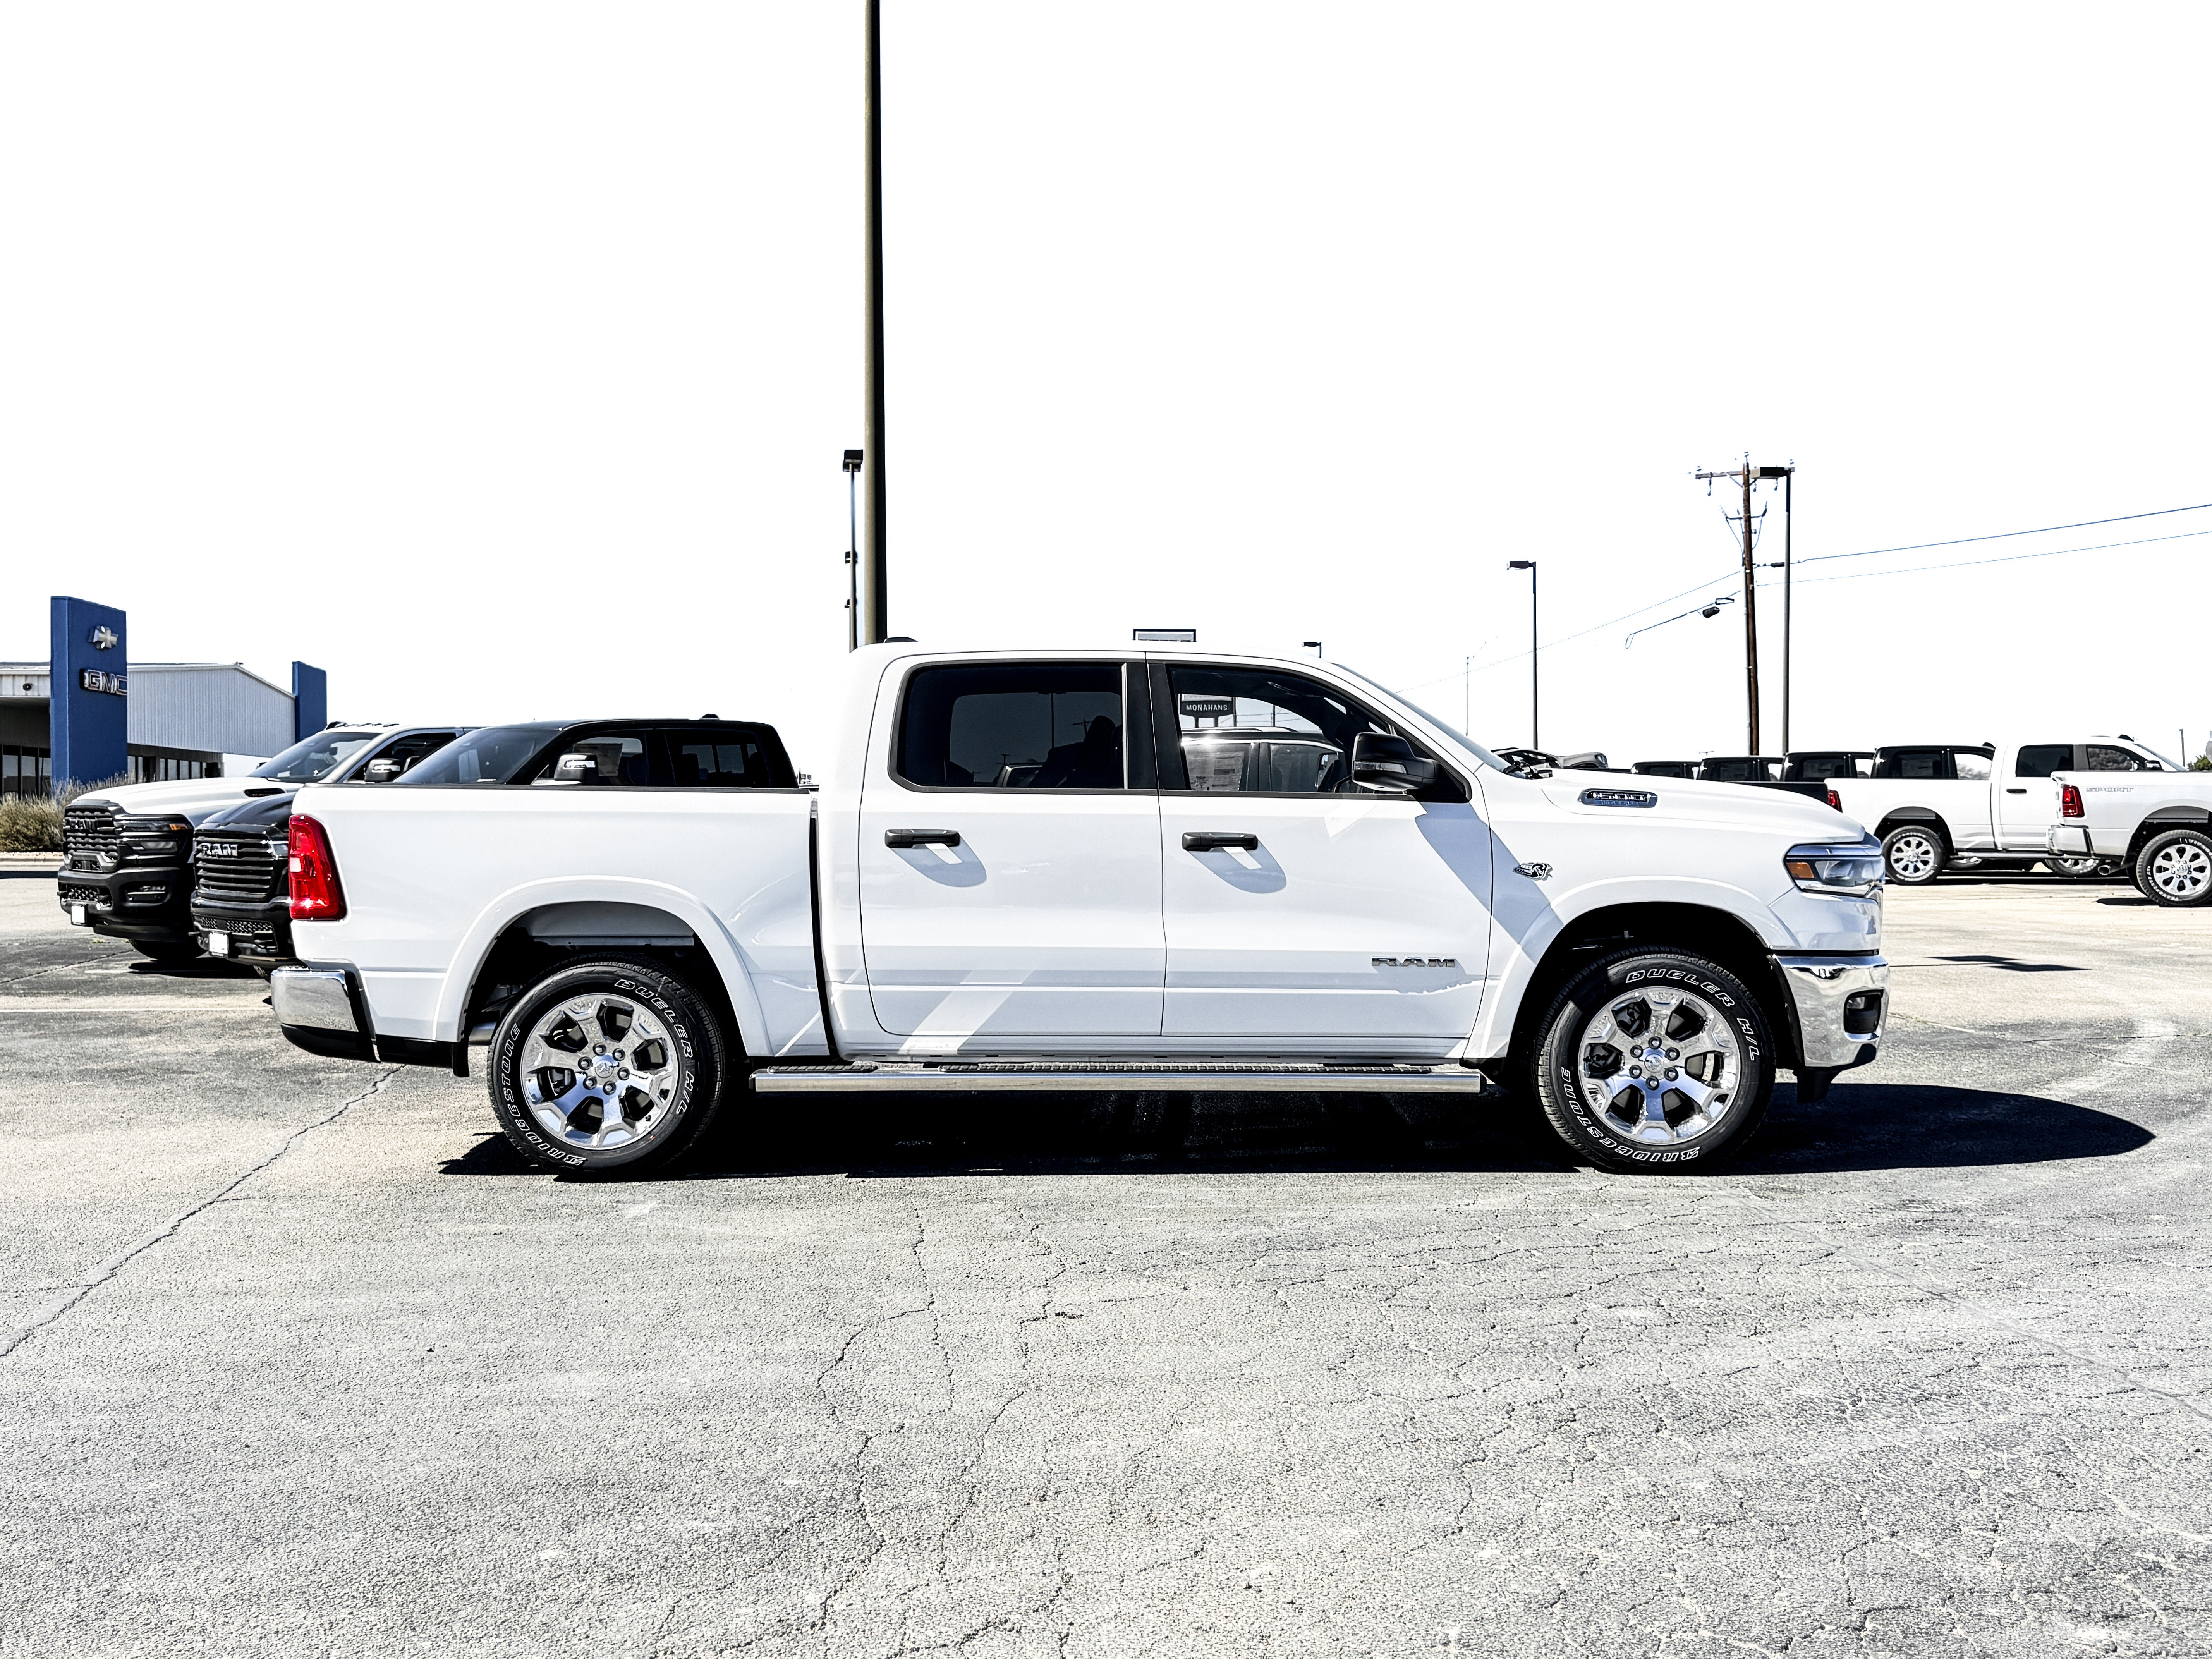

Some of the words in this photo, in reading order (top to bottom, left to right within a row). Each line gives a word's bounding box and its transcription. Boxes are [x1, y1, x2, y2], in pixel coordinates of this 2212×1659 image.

[87, 669, 127, 695] GMC
[199, 842, 239, 856] RAM
[1371, 956, 1456, 967] RAM
[614, 979, 693, 1058] DUELER
[676, 1070, 694, 1115] H/L
[1625, 969, 1735, 1007] DUELER
[1736, 1017, 1760, 1061] H/L
[501, 1022, 588, 1166] BRIDGESTONE
[1561, 1066, 1700, 1162] BRIDGESTONE
